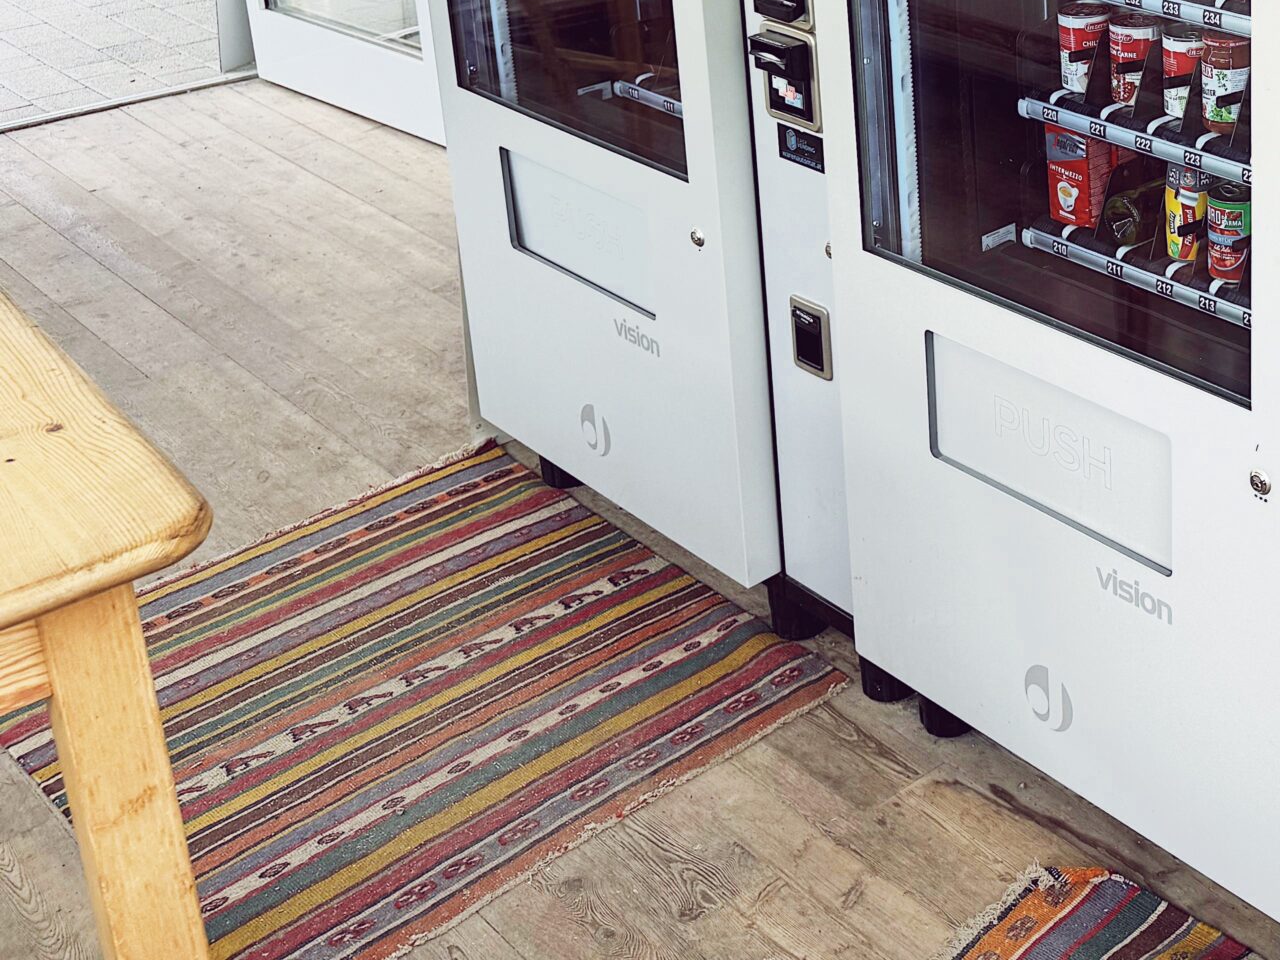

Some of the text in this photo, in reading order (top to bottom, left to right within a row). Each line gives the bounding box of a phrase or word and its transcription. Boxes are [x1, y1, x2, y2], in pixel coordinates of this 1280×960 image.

[1163, 2, 1179, 15] 233
[1204, 11, 1220, 25] 234
[1043, 108, 1057, 121] 220
[1090, 123, 1104, 136] 221
[1136, 137, 1150, 150] 222
[1185, 151, 1200, 165] 223
[1050, 163, 1083, 181] INTERMEZZO
[1053, 243, 1067, 255] 210
[1107, 263, 1121, 276] 211
[1157, 282, 1172, 295] 212
[1200, 297, 1215, 311] 213
[613, 318, 660, 357] vision
[994, 394, 1112, 490] PUSH
[1095, 566, 1173, 625] vision
